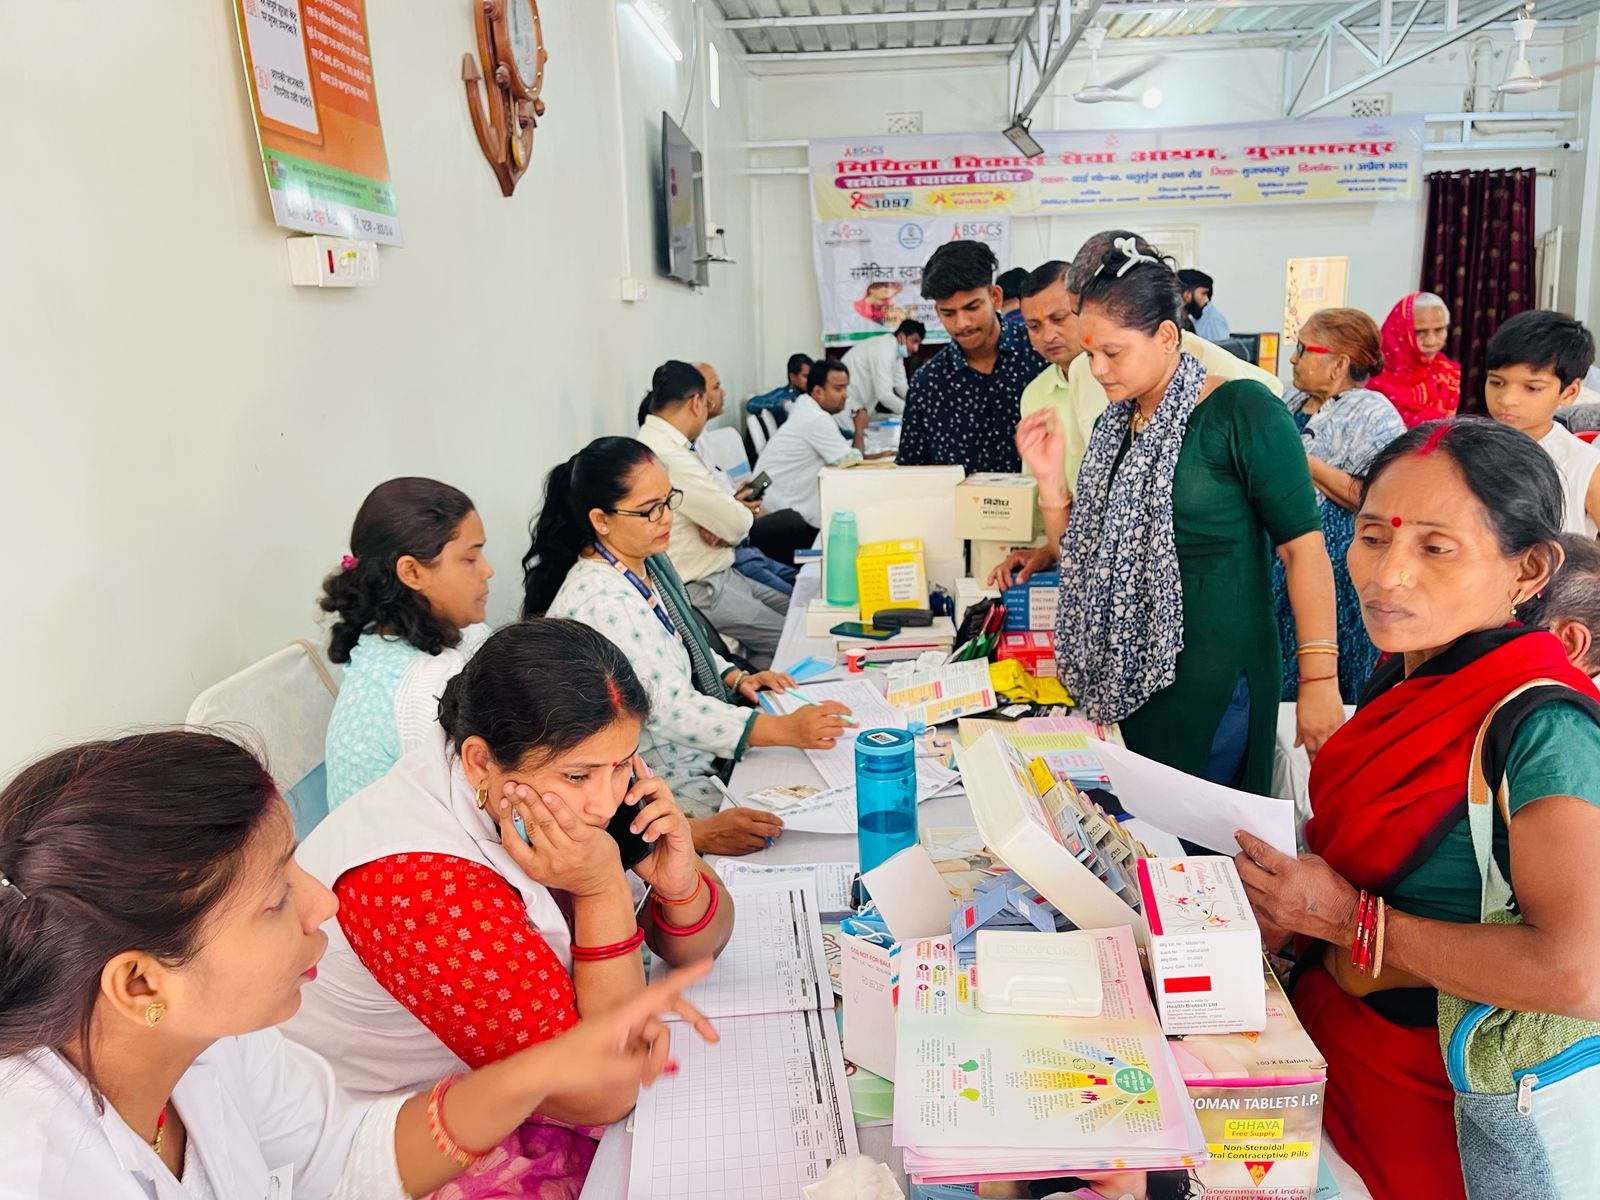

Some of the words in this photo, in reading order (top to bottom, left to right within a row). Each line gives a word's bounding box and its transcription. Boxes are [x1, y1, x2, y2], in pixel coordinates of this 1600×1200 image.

[875, 198, 910, 209] 1097
[962, 222, 1002, 236] BSACS
[849, 262, 895, 280] समेकित
[1243, 1095, 1299, 1110] TABLETS
[1301, 1093, 1320, 1108] I.P.
[1228, 1120, 1281, 1130] CHHAYA
[1249, 1129, 1276, 1138] Supply
[1223, 1143, 1285, 1151] Non-Steroidal
[1227, 1151, 1289, 1161] Contraceptive
[1290, 1149, 1309, 1158] Pills
